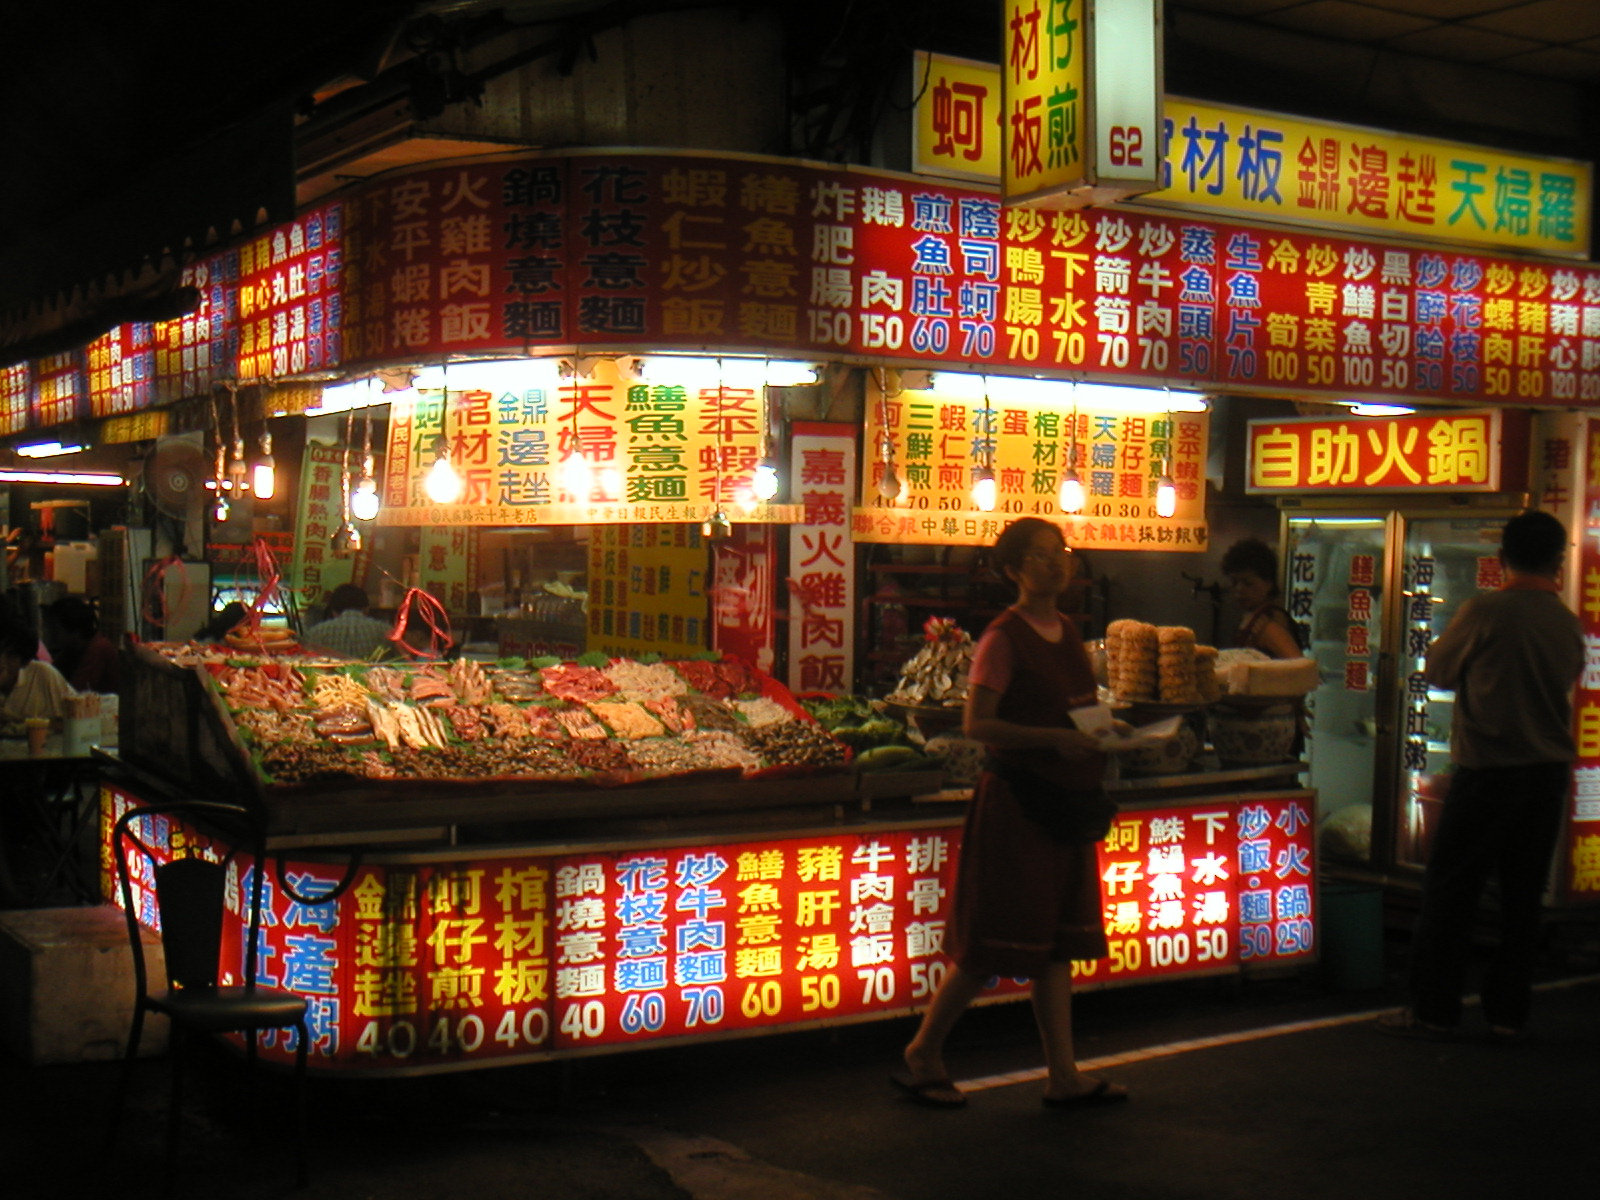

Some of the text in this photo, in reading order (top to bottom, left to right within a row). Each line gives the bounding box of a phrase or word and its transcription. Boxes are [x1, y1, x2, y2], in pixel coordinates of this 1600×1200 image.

[1109, 125, 1144, 167] 62
[1448, 158, 1577, 243] 天婦羅
[390, 179, 432, 348] 安平蝦捲
[439, 170, 492, 344] 火雞肉飯
[503, 165, 564, 340] 鍋燒意麵
[577, 164, 650, 337] 花枝意麵
[660, 166, 729, 339] 蝦仁炒飯
[807, 179, 855, 347] 炸肥腸 150
[911, 193, 954, 355] 煎魚肚 60
[1004, 207, 1045, 361] 炒鴨腸 70
[1050, 210, 1090, 365] 炒下水 70
[1137, 221, 1176, 371] 炒牛肉 70
[1179, 225, 1217, 375] 蒸魚頭 50
[1225, 232, 1264, 379] 生魚片 70
[1304, 243, 1339, 386] 炒青菜 50
[1379, 250, 1413, 389] 黑白切 50
[1549, 269, 1581, 371] 炒豬心
[860, 312, 904, 350] 150
[959, 322, 995, 357] 70
[1096, 334, 1129, 367] 70
[1265, 350, 1299, 382] 100
[1343, 356, 1374, 387] 100
[1416, 362, 1444, 392] 50
[1451, 257, 1484, 394] 炒花枝 50
[1485, 367, 1511, 396] 50
[1517, 266, 1550, 398] 炒豬肝 80
[625, 383, 689, 504] 鱔魚意麵
[905, 402, 935, 490] 三鮮煎
[937, 404, 967, 492] 蝦仁煎
[1030, 410, 1061, 496] 棺材板
[1088, 415, 1118, 497] 天婦羅
[1254, 416, 1489, 487] 自助火鍋
[798, 448, 846, 692] 嘉義火雞肉飯
[1345, 555, 1375, 691] 鱔魚意麵
[555, 863, 607, 1040] 鍋燒意麵 40
[614, 857, 669, 1034] 花枝意麵 60
[674, 852, 729, 1028] 炒牛肉麵 70
[735, 849, 785, 1019] 鱔魚意麵 60
[795, 845, 844, 1012] 豬肝湯 50
[849, 841, 896, 1005] 牛肉燴飯 70
[904, 836, 948, 998] 排骨飯 50
[1102, 819, 1144, 973] 蚵仔湯 50
[1146, 932, 1190, 968] 100
[1190, 811, 1230, 962] 下水湯 50
[1239, 924, 1273, 960] 50
[1274, 802, 1314, 956] 小火鍋 250
[426, 869, 488, 1055] 蚵仔煎 40
[494, 865, 550, 1048] 棺材板 40
[355, 1020, 418, 1059] 40
